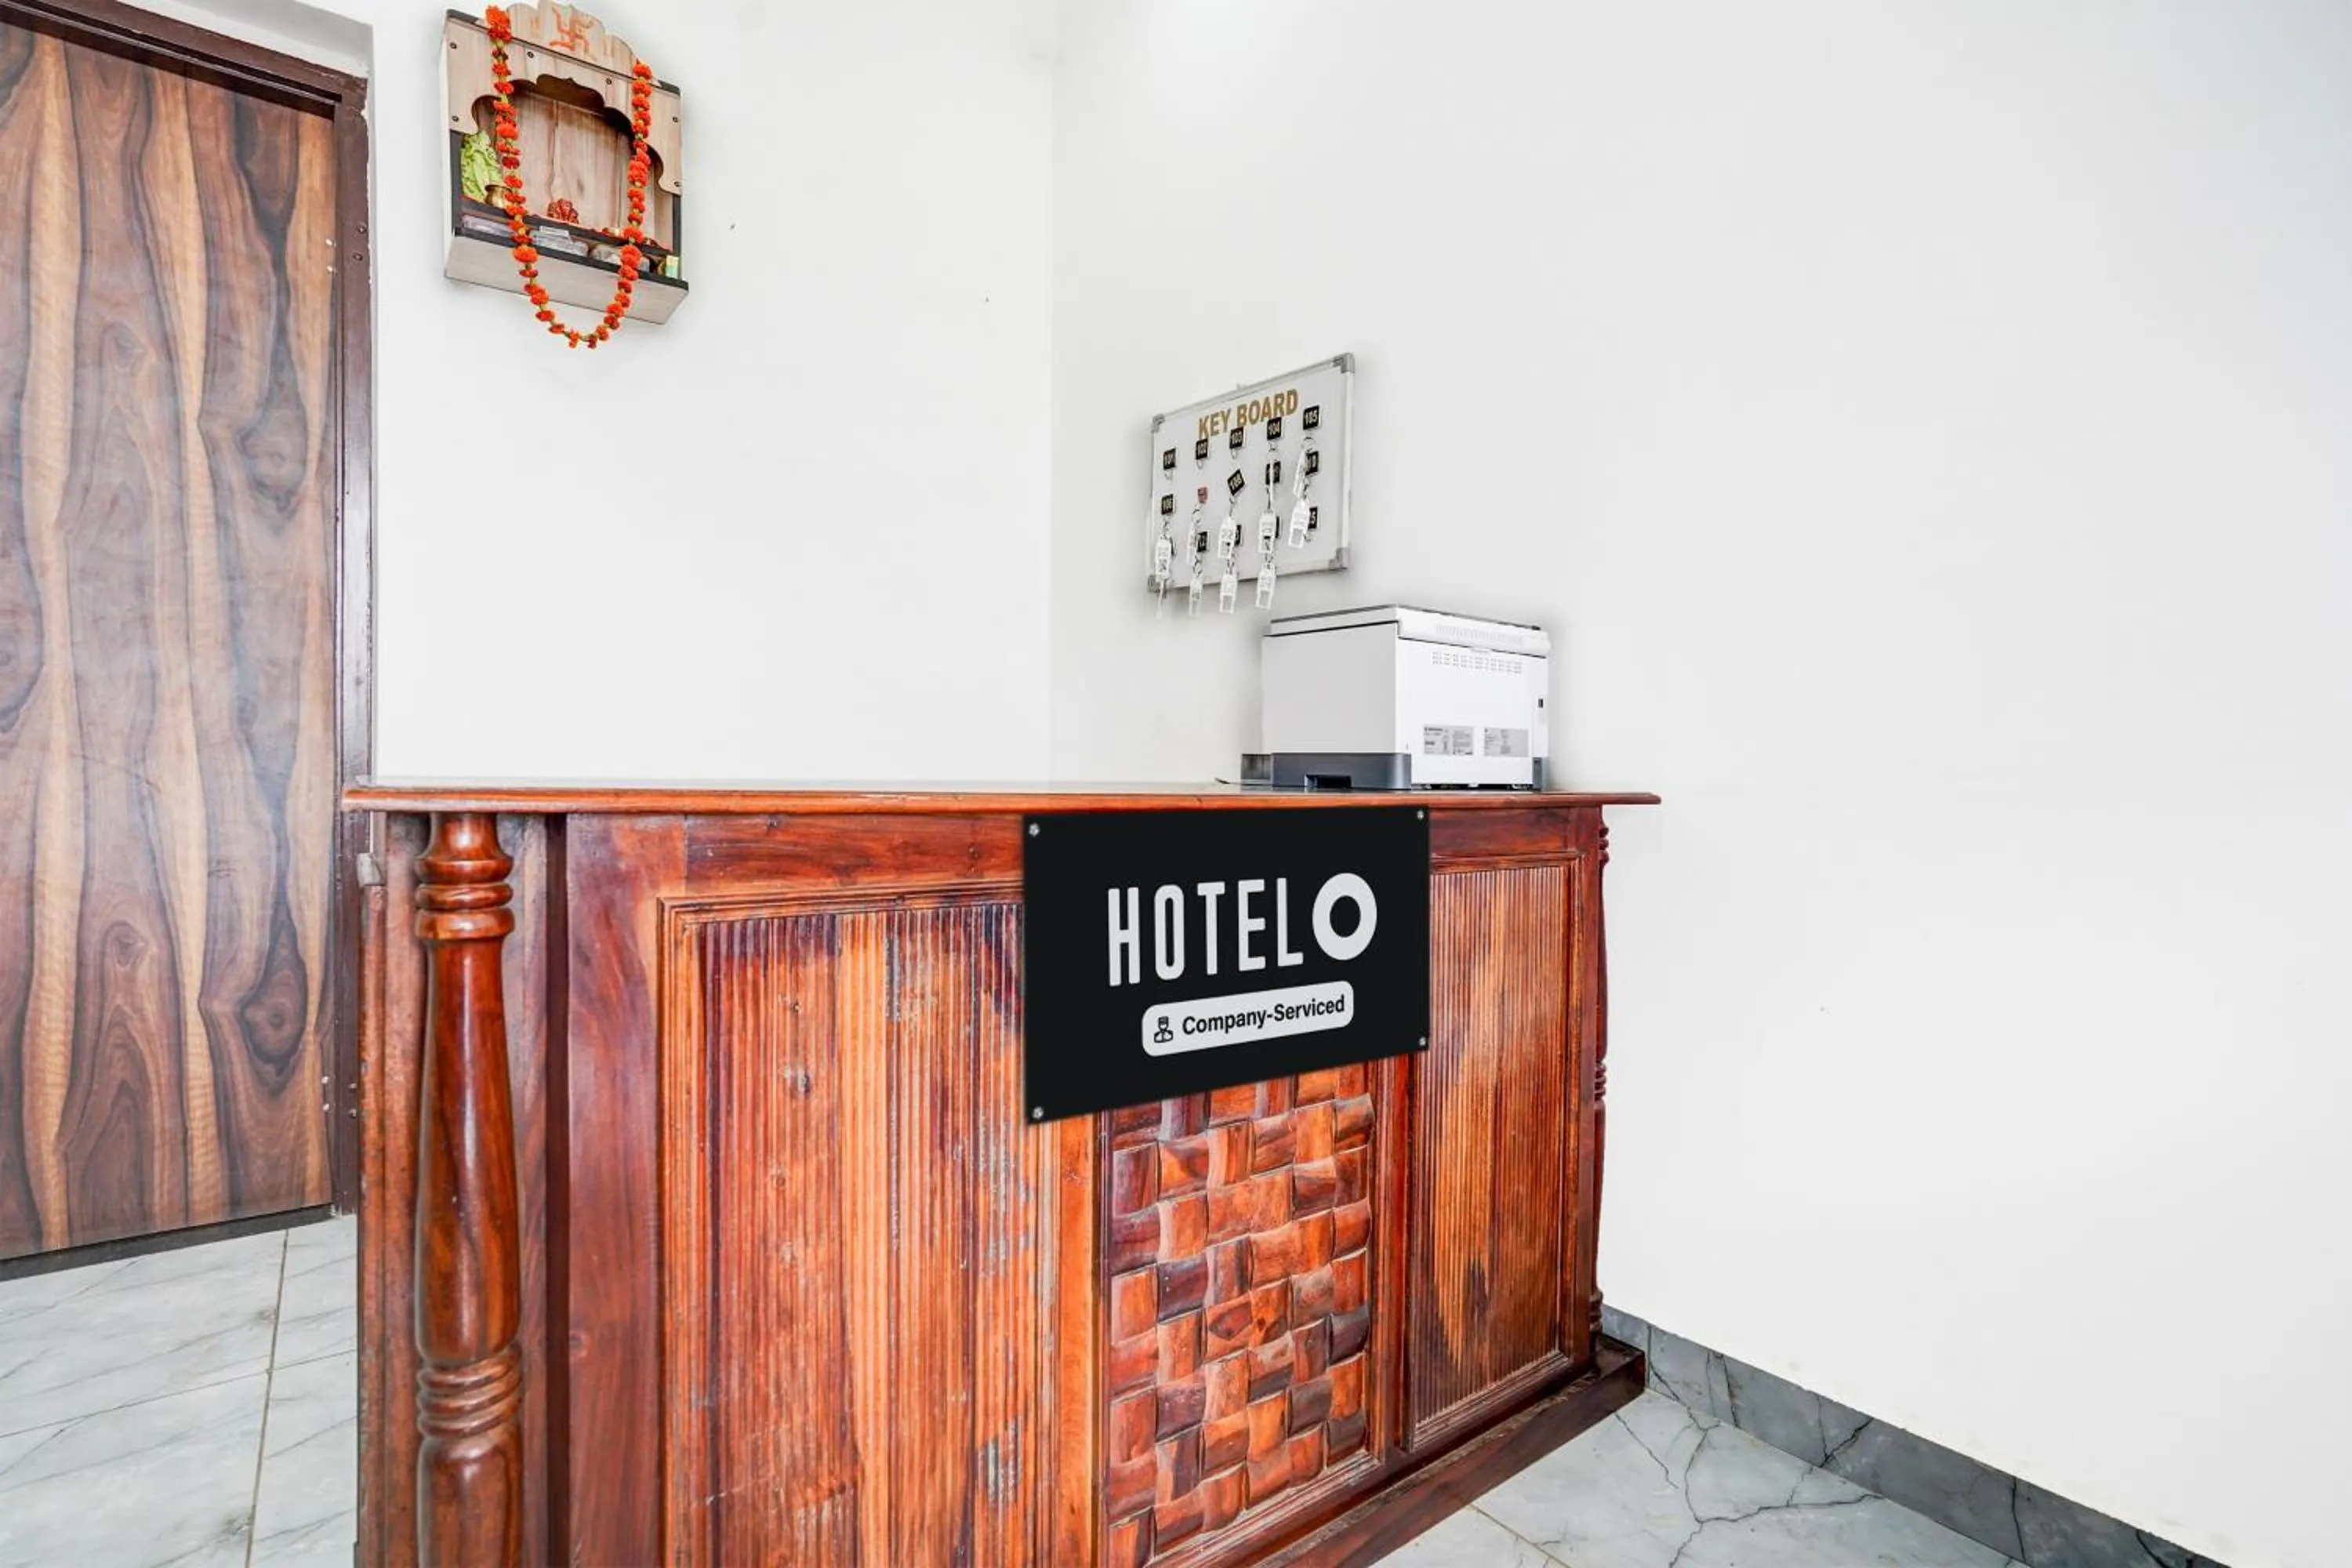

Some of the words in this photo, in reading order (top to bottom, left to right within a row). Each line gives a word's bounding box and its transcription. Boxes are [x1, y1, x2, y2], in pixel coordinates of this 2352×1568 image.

[1198, 408, 1232, 438] KEY
[1236, 389, 1298, 428] BOARD
[1107, 877, 1304, 987] HOTEL
[1182, 993, 1345, 1036] Company-Serviced
